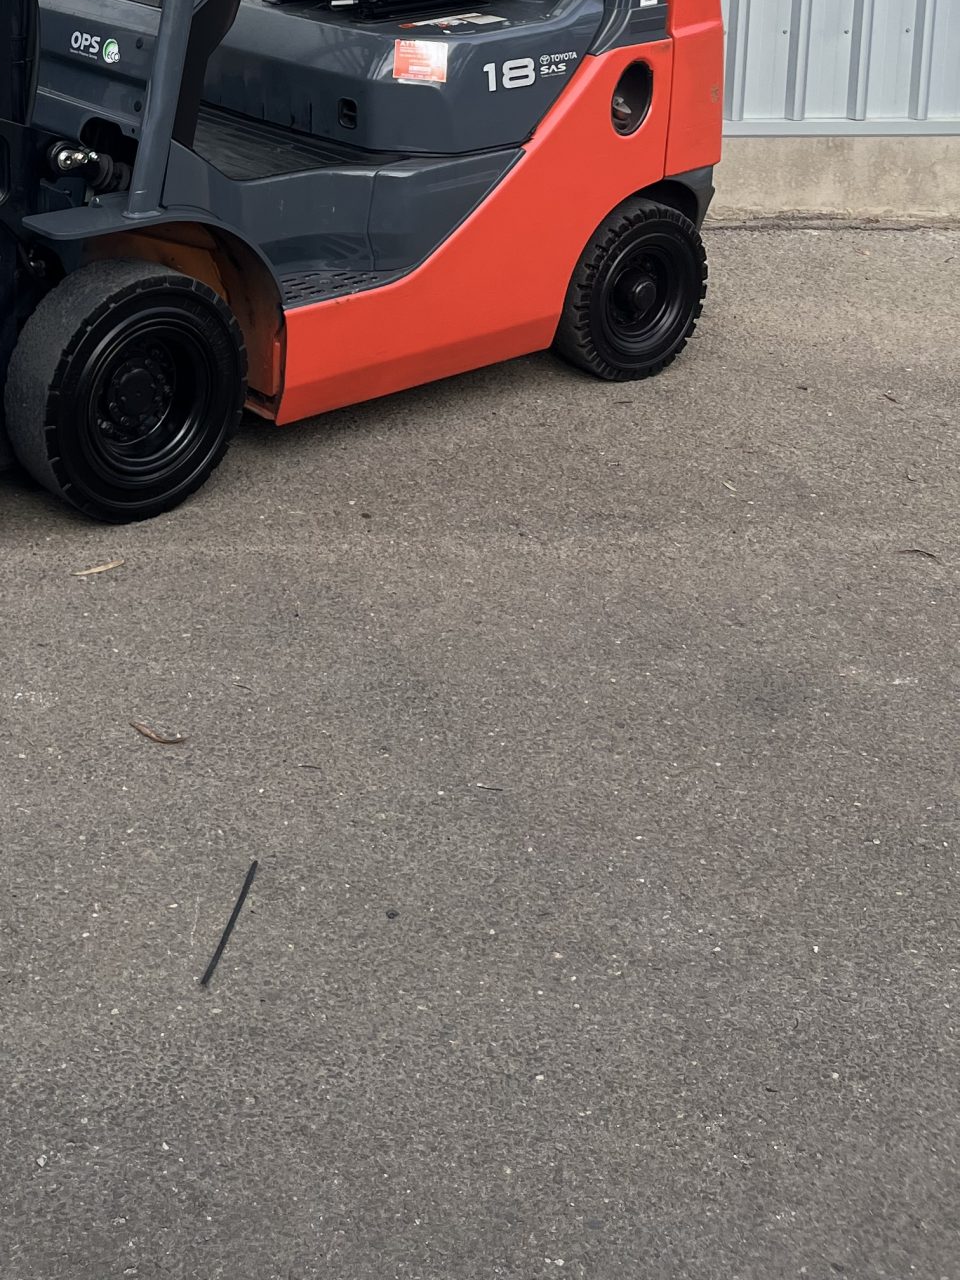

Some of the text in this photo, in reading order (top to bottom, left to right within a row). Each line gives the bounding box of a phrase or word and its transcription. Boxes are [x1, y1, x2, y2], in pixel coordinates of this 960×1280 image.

[71, 31, 101, 53] OPS
[550, 51, 577, 62] TOYOTA
[483, 57, 535, 92] 18
[540, 63, 567, 74] SAS
